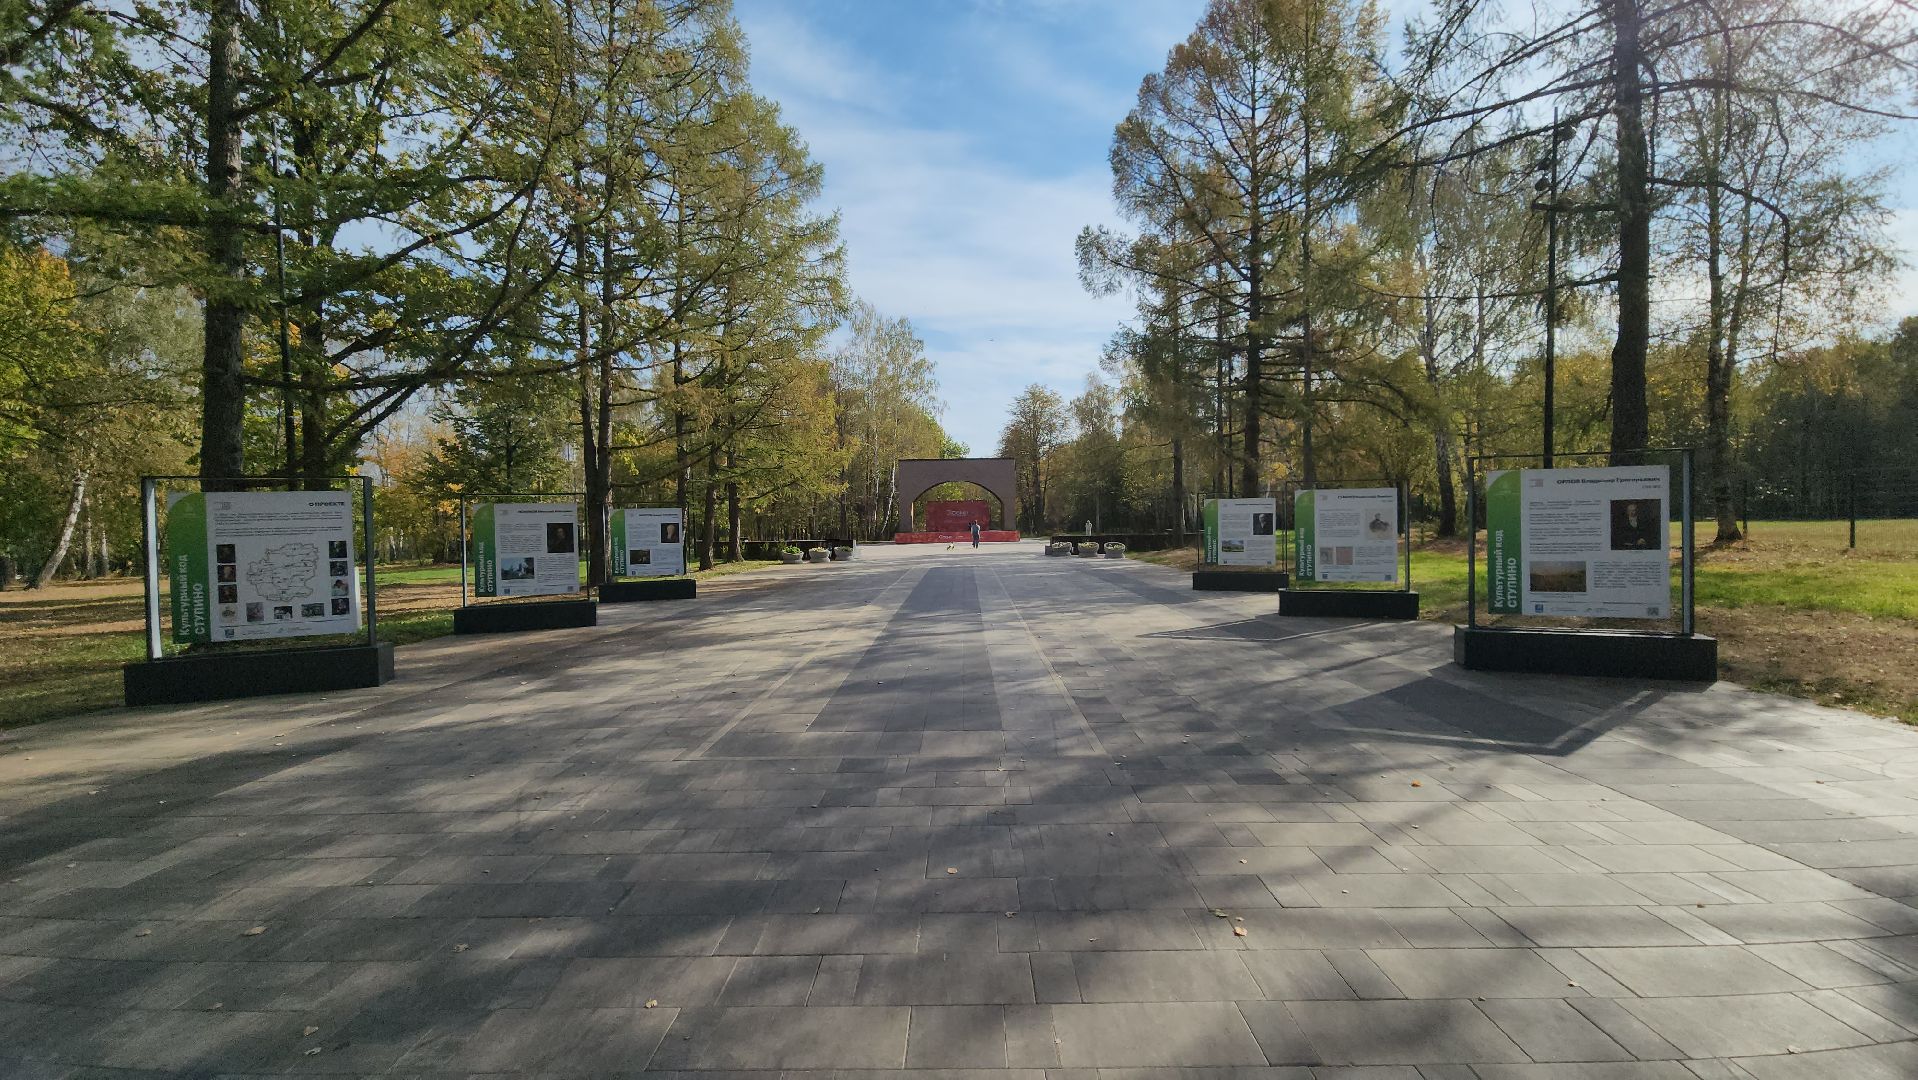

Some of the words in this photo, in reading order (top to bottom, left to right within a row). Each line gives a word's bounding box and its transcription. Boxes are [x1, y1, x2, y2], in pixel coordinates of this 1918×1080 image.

[178, 554, 189, 573] код
[1495, 529, 1504, 547] код
[1494, 549, 1505, 608] Культурный
[1507, 557, 1518, 608] СТУПИНО
[178, 575, 192, 636] Культурный
[193, 583, 206, 635] СТУПИНО
